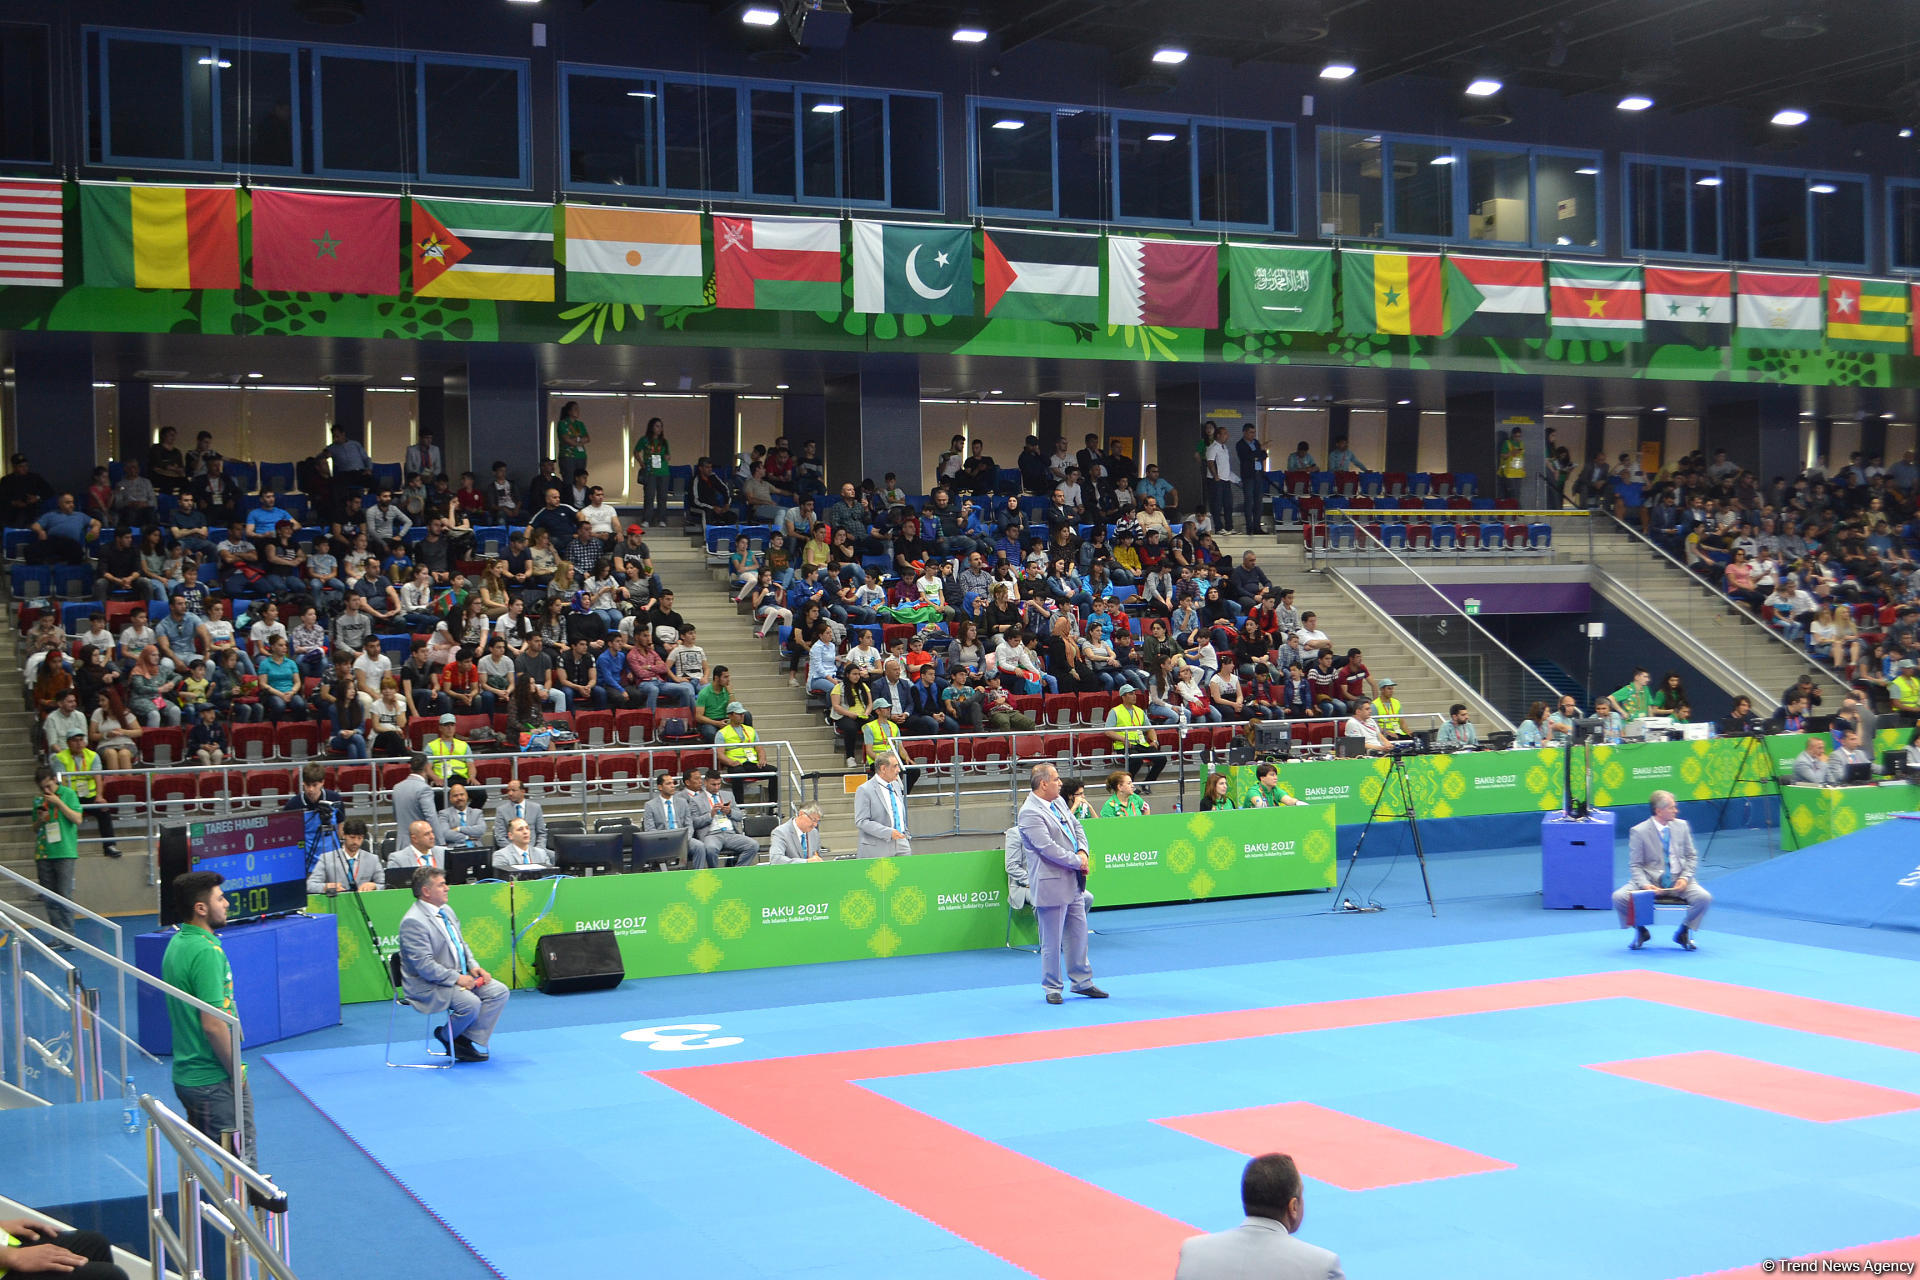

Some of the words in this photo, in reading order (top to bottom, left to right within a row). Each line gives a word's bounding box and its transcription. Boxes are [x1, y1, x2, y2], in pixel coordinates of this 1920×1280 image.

[1474, 776, 1495, 785] BAKU
[1496, 774, 1516, 784] 2017
[1305, 787, 1327, 796] BAKU
[1328, 785, 1350, 795] 2017
[235, 815, 269, 831] HAMEDI
[245, 833, 255, 851] 0
[1244, 842, 1269, 853] BAKU
[1271, 840, 1295, 851] 2017
[246, 854, 256, 872] 0
[1105, 852, 1131, 863] BAKU
[1133, 850, 1158, 861] 2017
[937, 893, 968, 905] BAKU
[971, 890, 1000, 902] 2017
[762, 906, 794, 918] BAKU
[798, 903, 829, 915] 2017
[575, 919, 610, 932] BAKU
[614, 916, 647, 929] 2017
